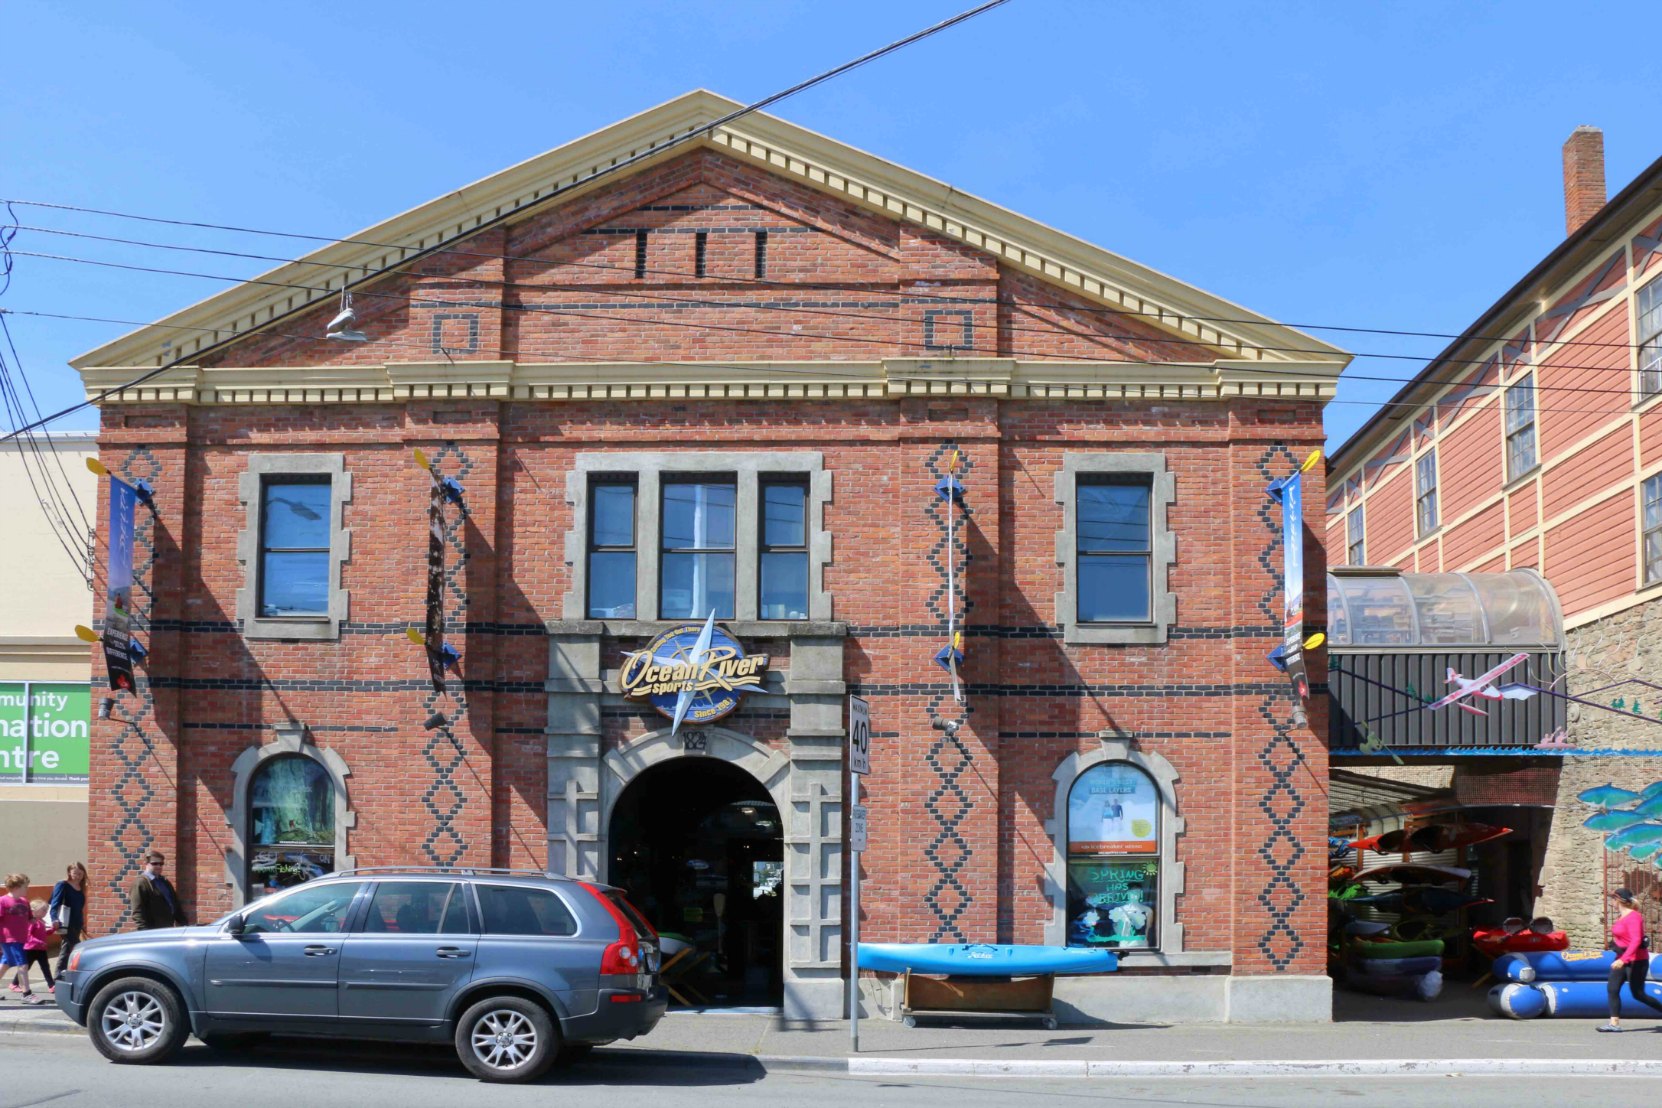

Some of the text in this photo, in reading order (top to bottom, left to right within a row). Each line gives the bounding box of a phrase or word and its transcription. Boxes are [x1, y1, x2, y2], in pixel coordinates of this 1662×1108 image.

[621, 647, 764, 692] Ocean River
[652, 681, 693, 696] sports
[694, 708, 716, 719] Since
[683, 731, 707, 750] 1824
[852, 719, 868, 755] 40
[854, 756, 867, 770] kmh
[1089, 867, 1144, 882] SPRING
[1106, 883, 1128, 891] HAS
